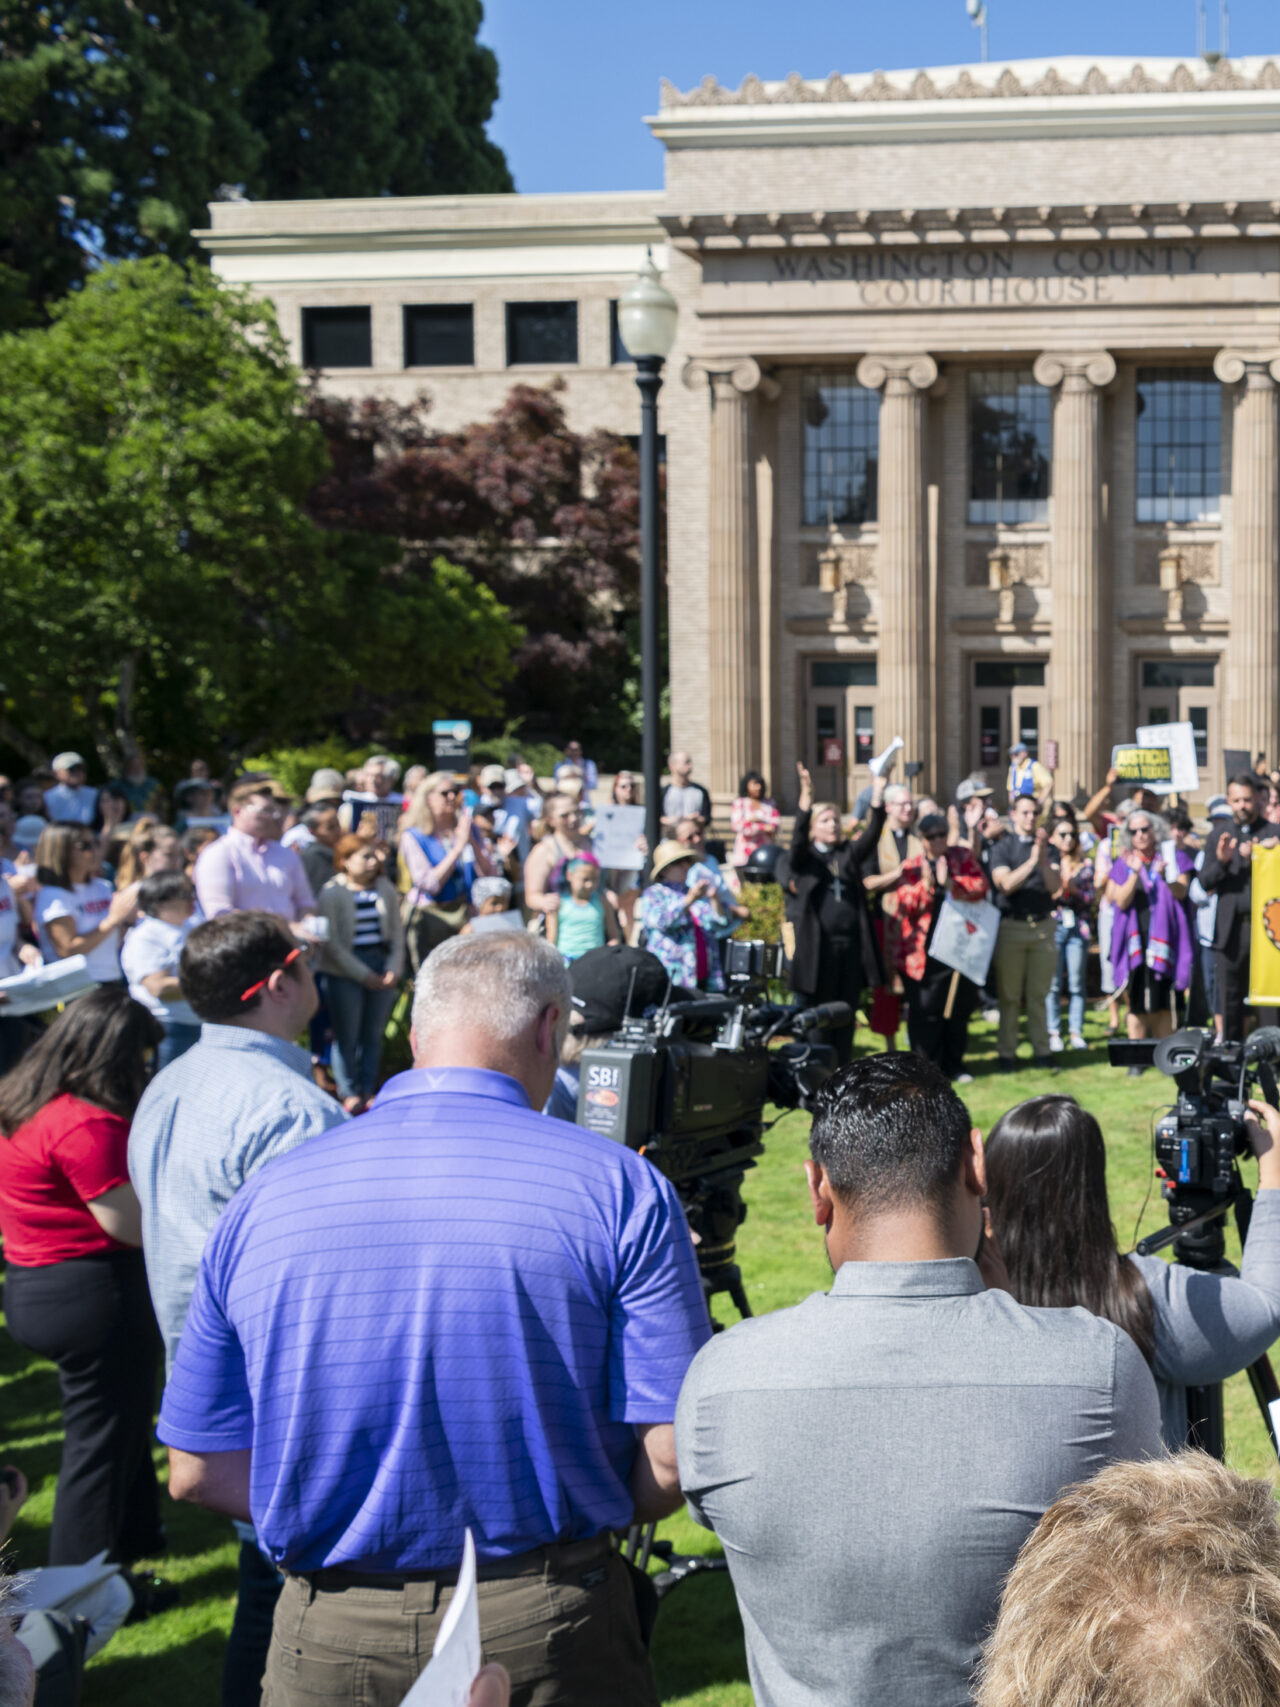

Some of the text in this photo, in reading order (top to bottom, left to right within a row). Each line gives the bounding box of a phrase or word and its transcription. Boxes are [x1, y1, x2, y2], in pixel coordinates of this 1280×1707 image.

[773, 247, 1204, 280] WASHINGTON COUNTY
[858, 276, 1114, 307] COURTHOUSE
